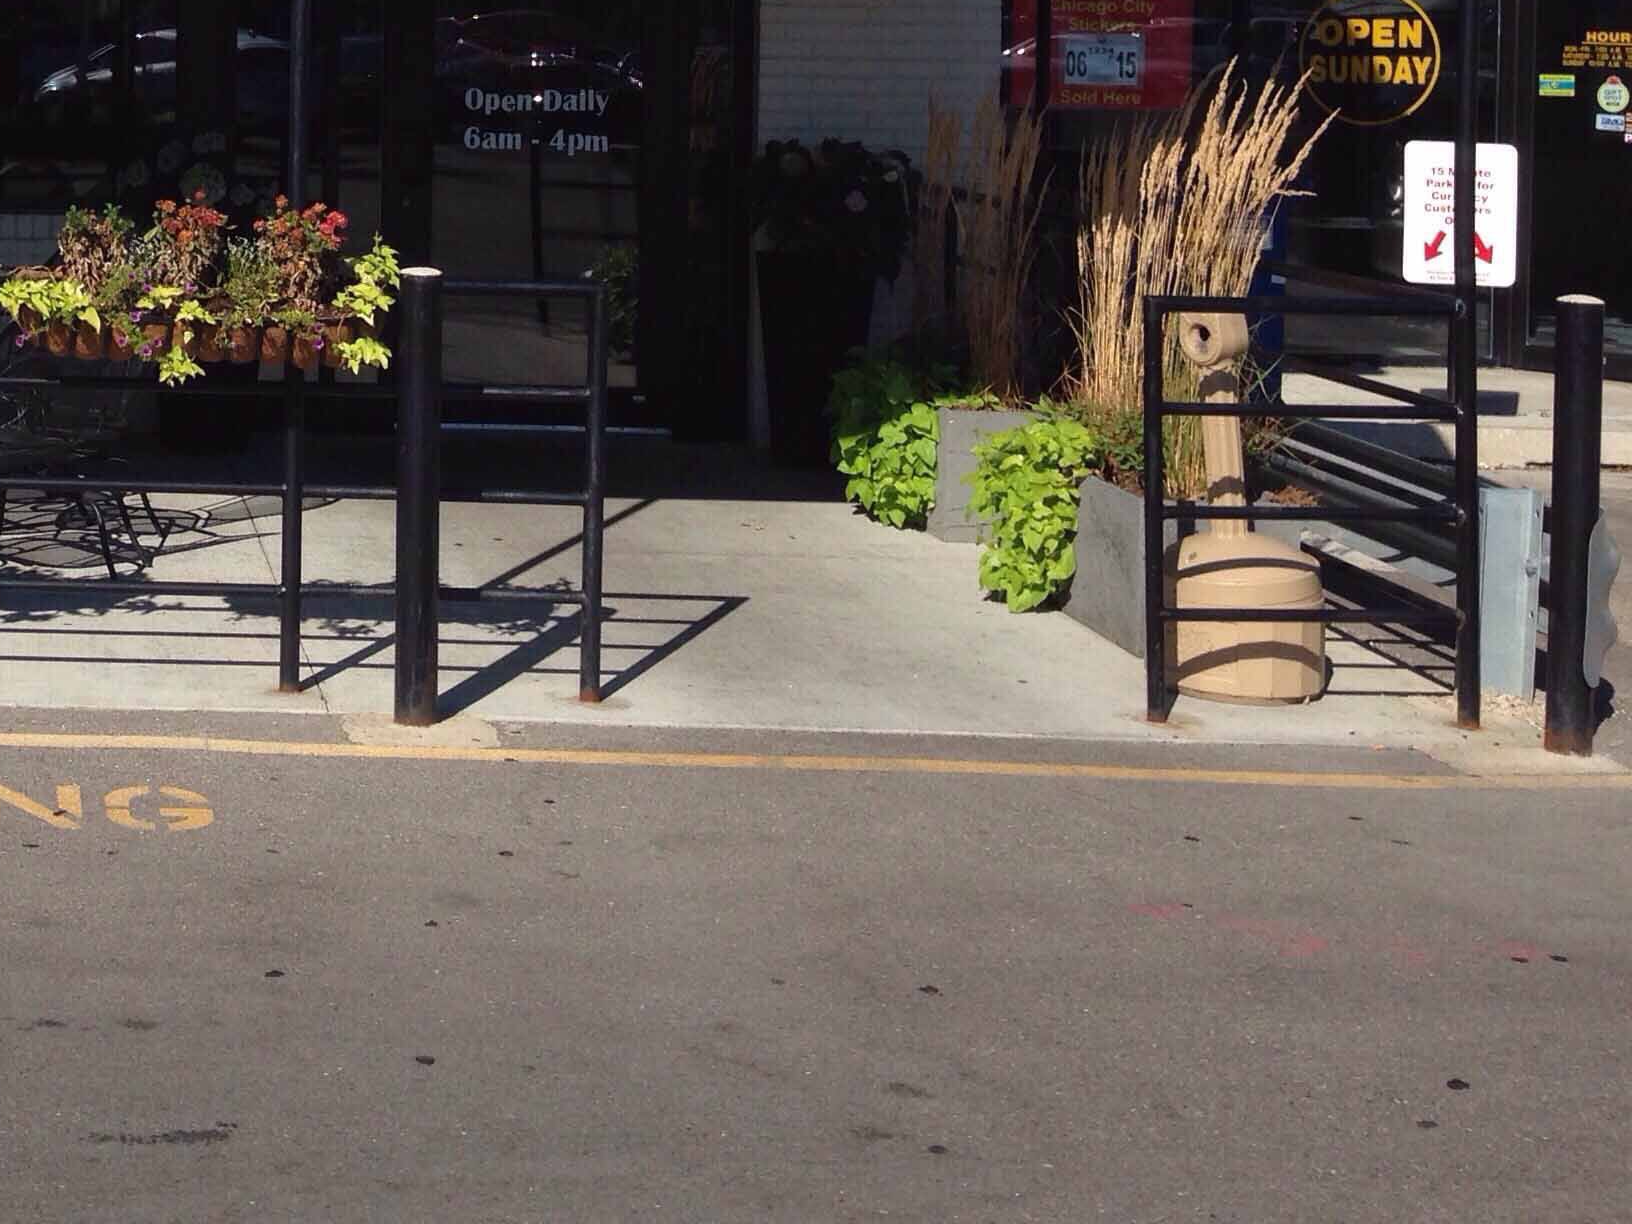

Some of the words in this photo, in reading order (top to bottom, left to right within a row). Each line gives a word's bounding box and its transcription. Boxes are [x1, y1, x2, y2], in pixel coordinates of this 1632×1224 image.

[1070, 17, 1136, 32] Stickers
[1319, 18, 1423, 49] OPEN
[1585, 31, 1632, 43] HOUR
[1066, 50, 1088, 77] 06
[1116, 51, 1137, 79] 15
[1311, 54, 1433, 85] SUNDAY
[465, 87, 533, 115] Open
[543, 88, 609, 117] Daily
[1061, 88, 1098, 104] Sold
[1103, 89, 1142, 105] Here
[464, 126, 522, 151] 6am
[549, 128, 609, 156] 4pm
[1431, 166, 1445, 177] 15
[1477, 182, 1495, 190] for
[1431, 191, 1489, 205] Curcy
[1424, 202, 1492, 215] Custrs
